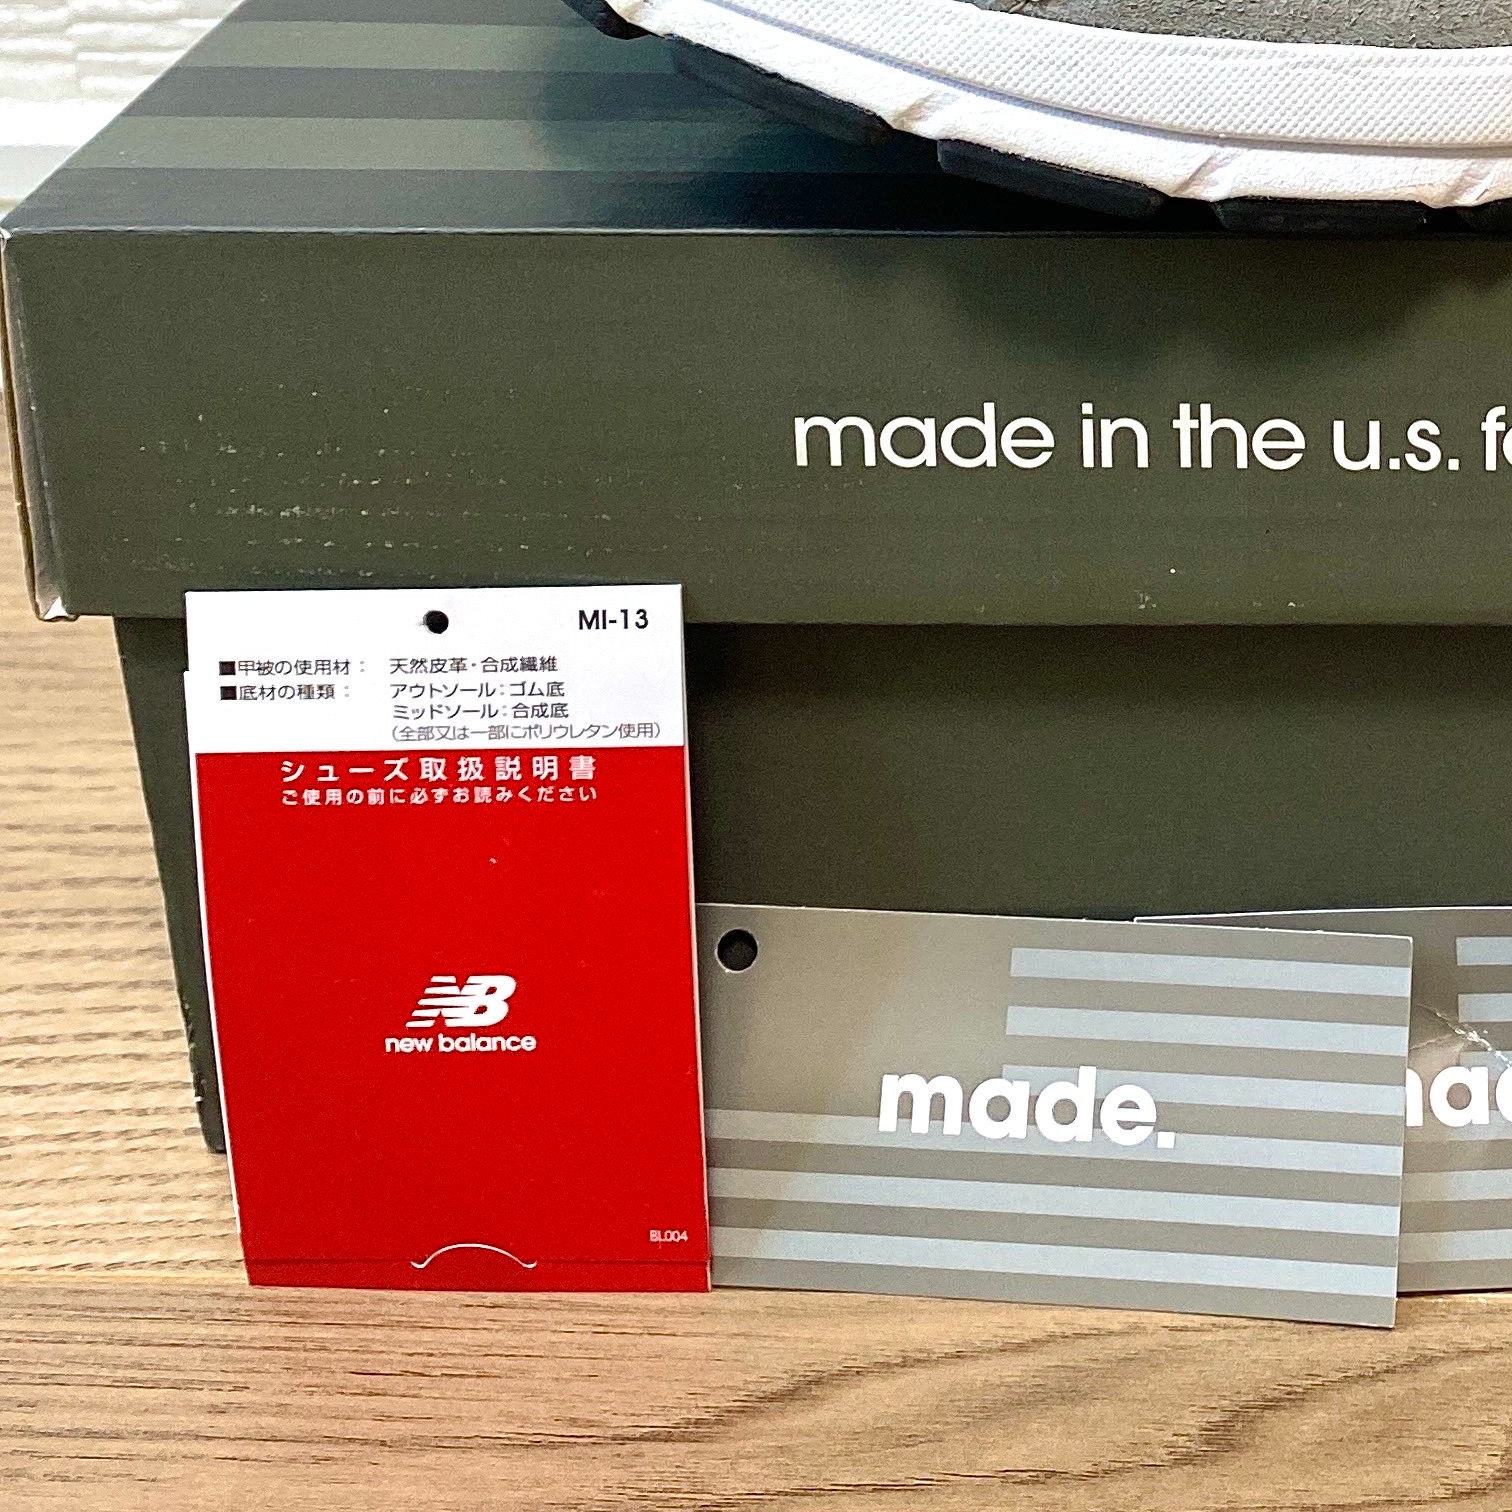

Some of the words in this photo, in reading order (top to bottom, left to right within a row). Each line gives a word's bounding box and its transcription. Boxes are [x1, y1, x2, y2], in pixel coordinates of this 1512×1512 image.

[794, 402, 1055, 469] made
[1081, 402, 1149, 468] in
[1172, 403, 1306, 470] the
[1333, 419, 1460, 472] u.s.
[578, 608, 649, 631] MI-13
[280, 754, 597, 783] シューズ取扱説明書
[281, 785, 598, 807] ご使用の前に必ずお読みください
[405, 974, 517, 1028] NB
[384, 1036, 434, 1054] new
[437, 1032, 538, 1053] balance
[878, 1065, 1177, 1149] made.
[649, 1229, 689, 1243] BL004
